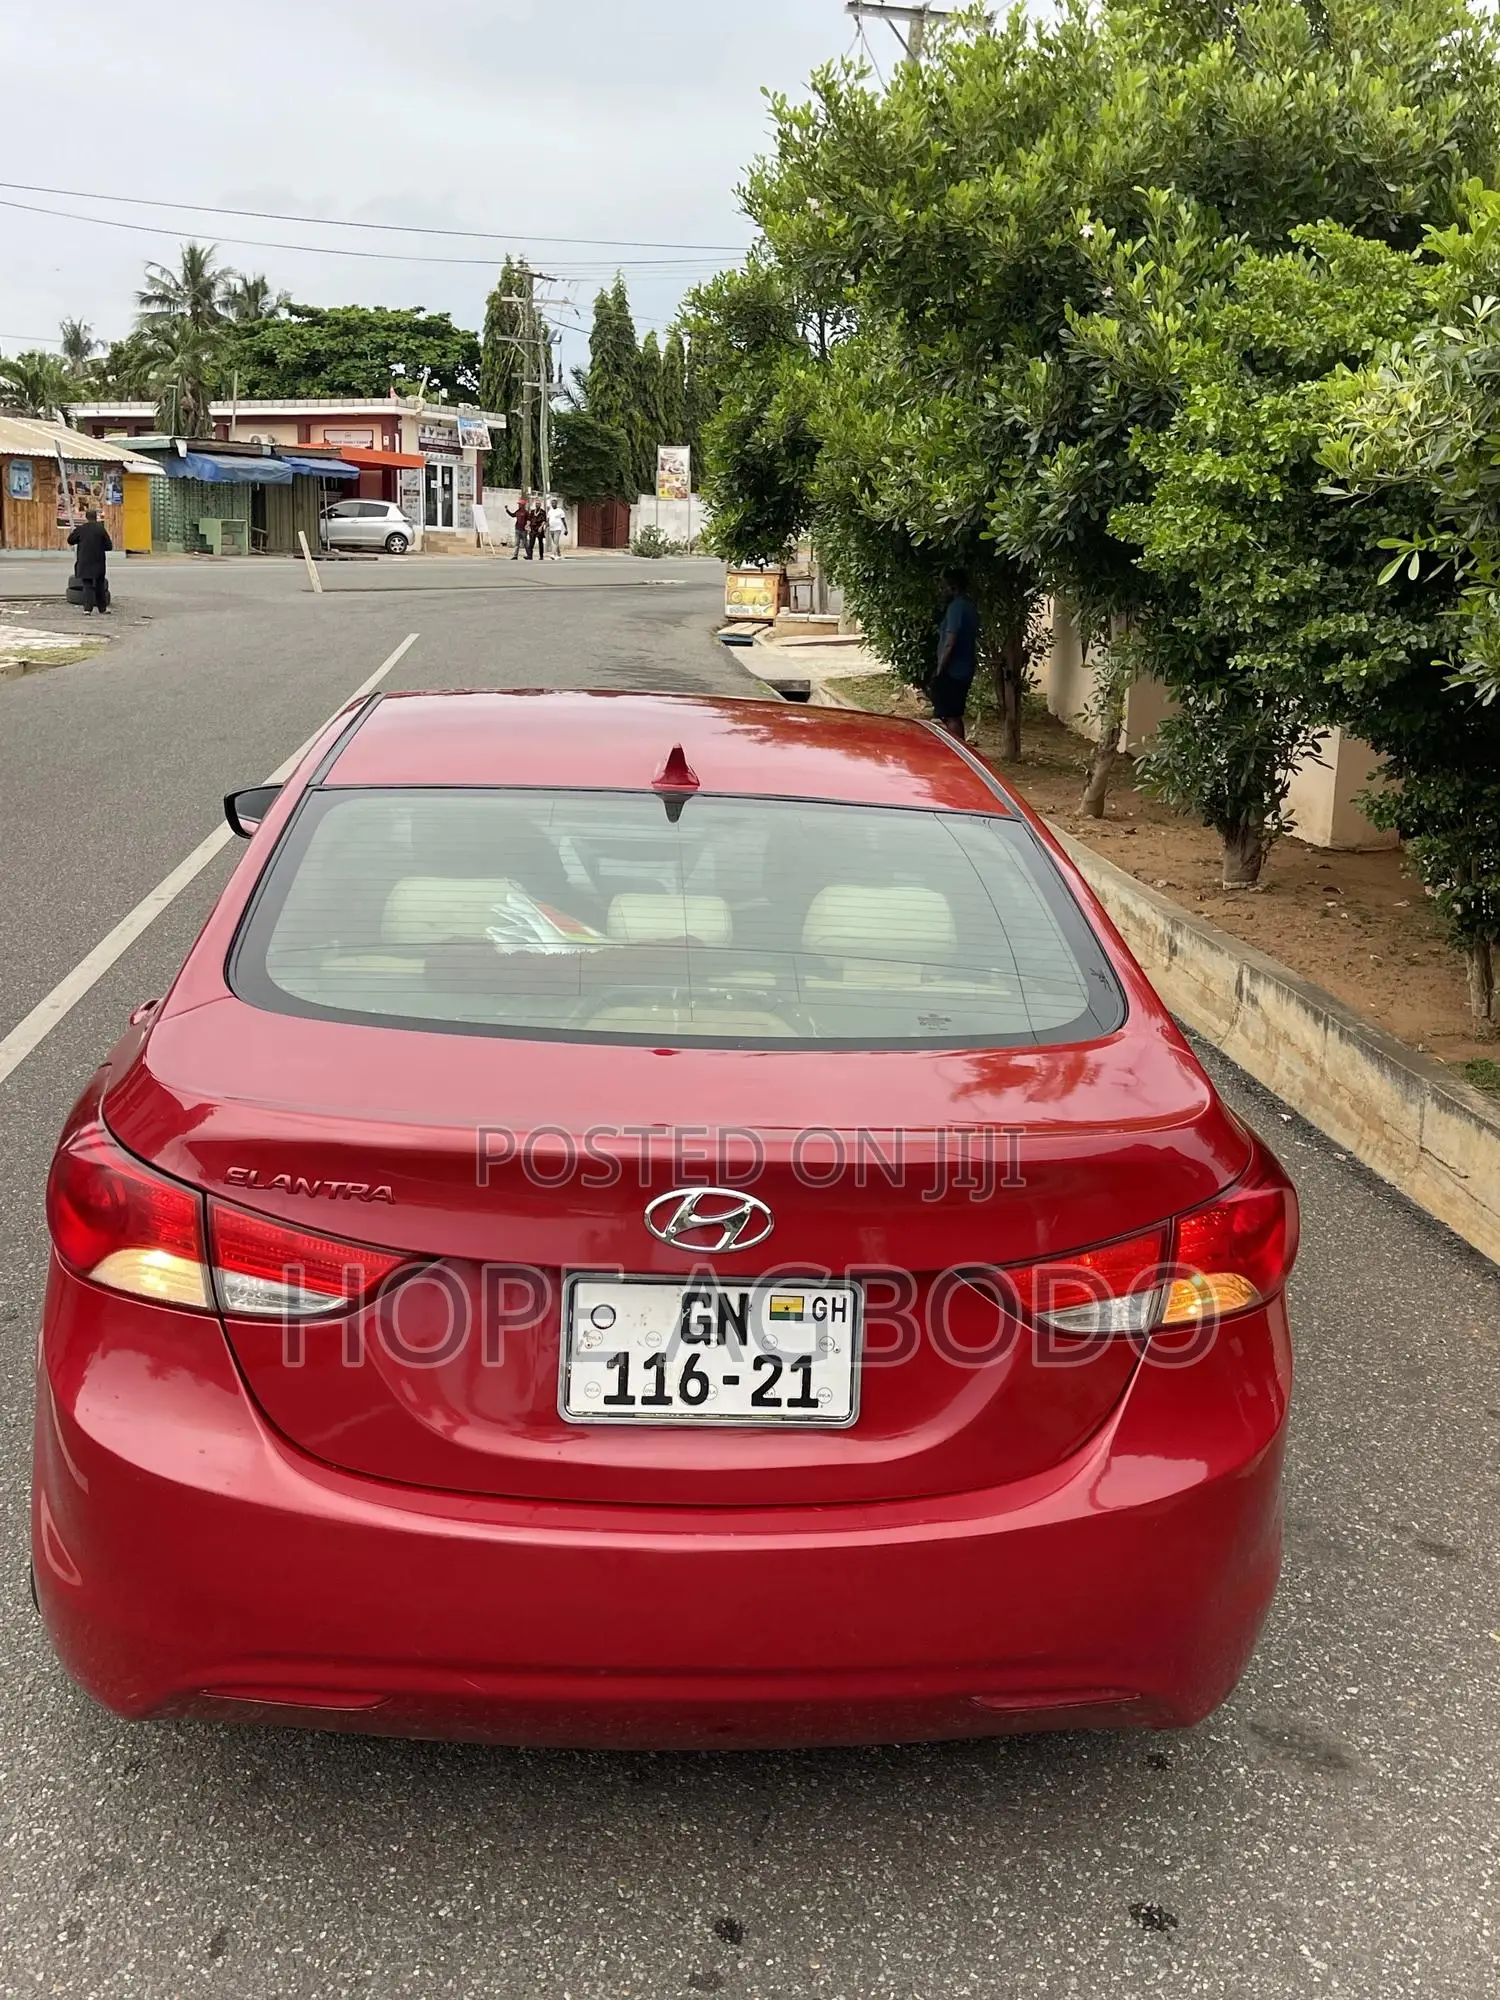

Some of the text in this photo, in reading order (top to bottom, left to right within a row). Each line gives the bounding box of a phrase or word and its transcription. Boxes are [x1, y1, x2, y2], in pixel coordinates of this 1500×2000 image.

[224, 1166, 396, 1204] ELANTRA
[681, 1292, 749, 1345] GN
[812, 1297, 847, 1322] GH
[603, 1351, 819, 1408] 116-21
